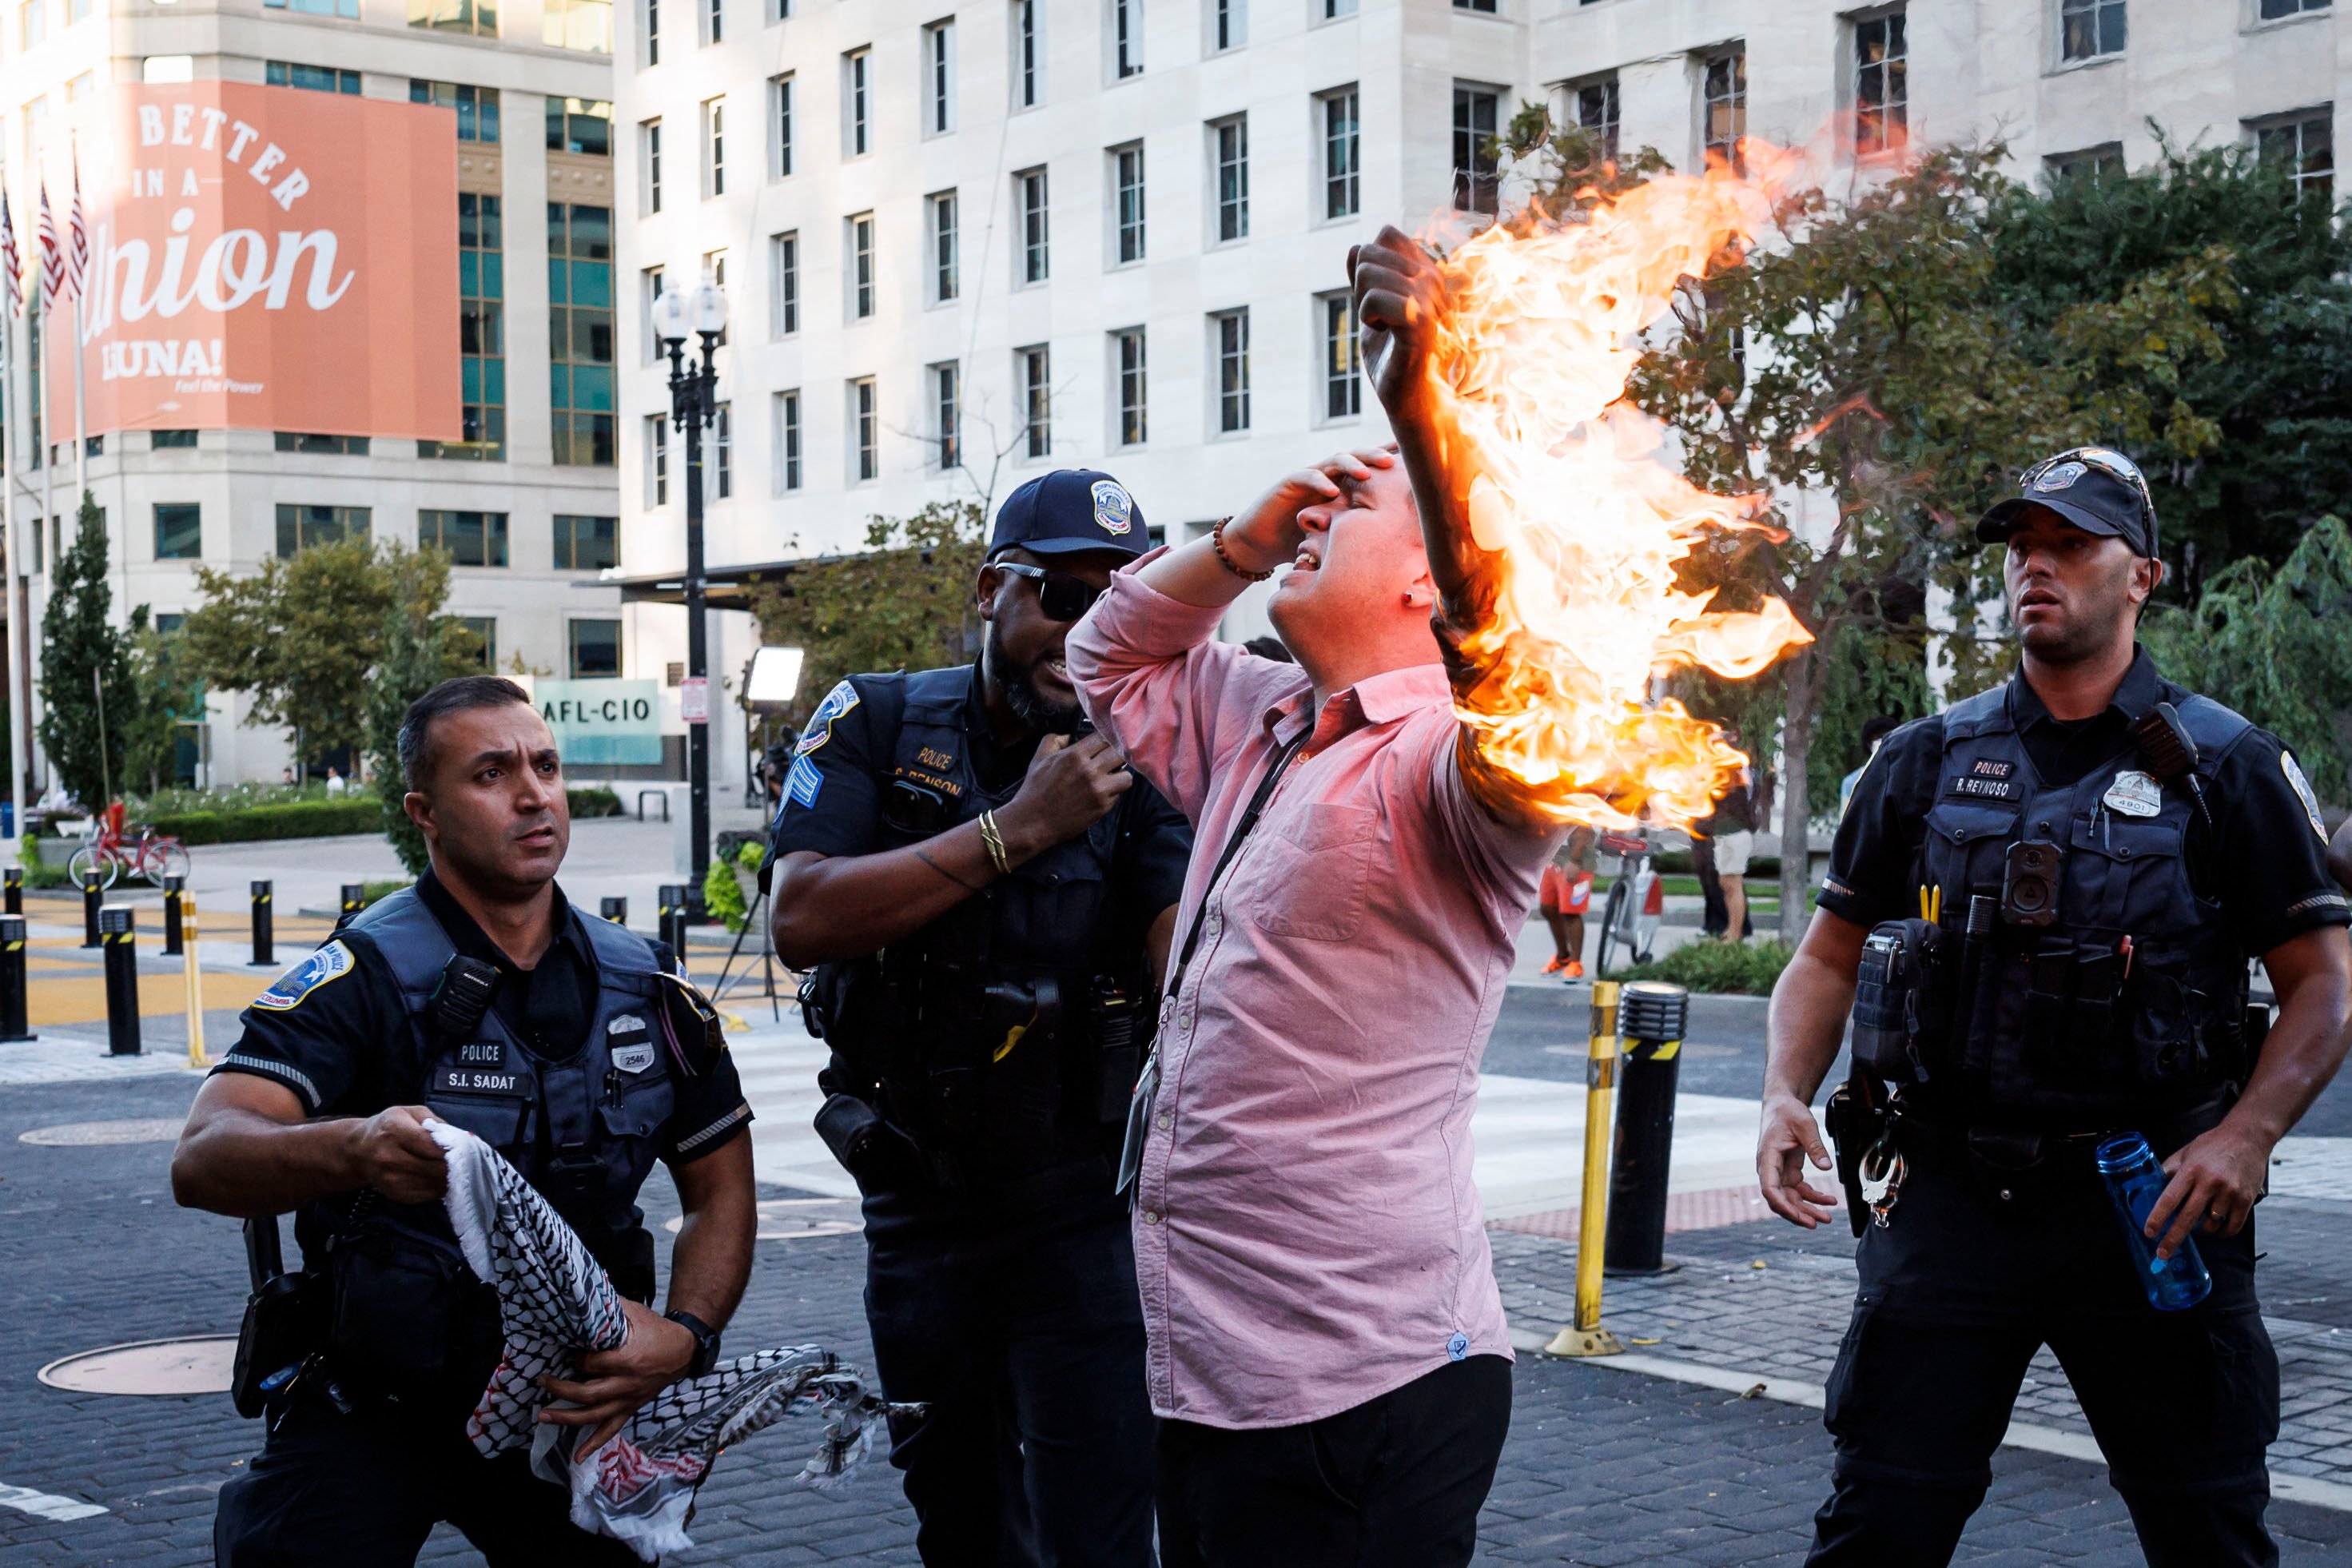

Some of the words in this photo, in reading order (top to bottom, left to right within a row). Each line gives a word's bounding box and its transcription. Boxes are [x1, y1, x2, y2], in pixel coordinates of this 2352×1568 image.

[138, 102, 310, 212] BETTER
[133, 168, 164, 197] IN
[181, 167, 199, 197] A
[543, 698, 650, 722] AFL-CIO
[915, 746, 953, 770] POLICE
[1974, 761, 2008, 776] POLICE
[1956, 778, 1964, 792] R.
[1965, 779, 2009, 797] REYNOSO
[461, 1045, 499, 1061] POLICE
[448, 1073, 469, 1088] S.I.
[473, 1075, 516, 1090] SADAT
